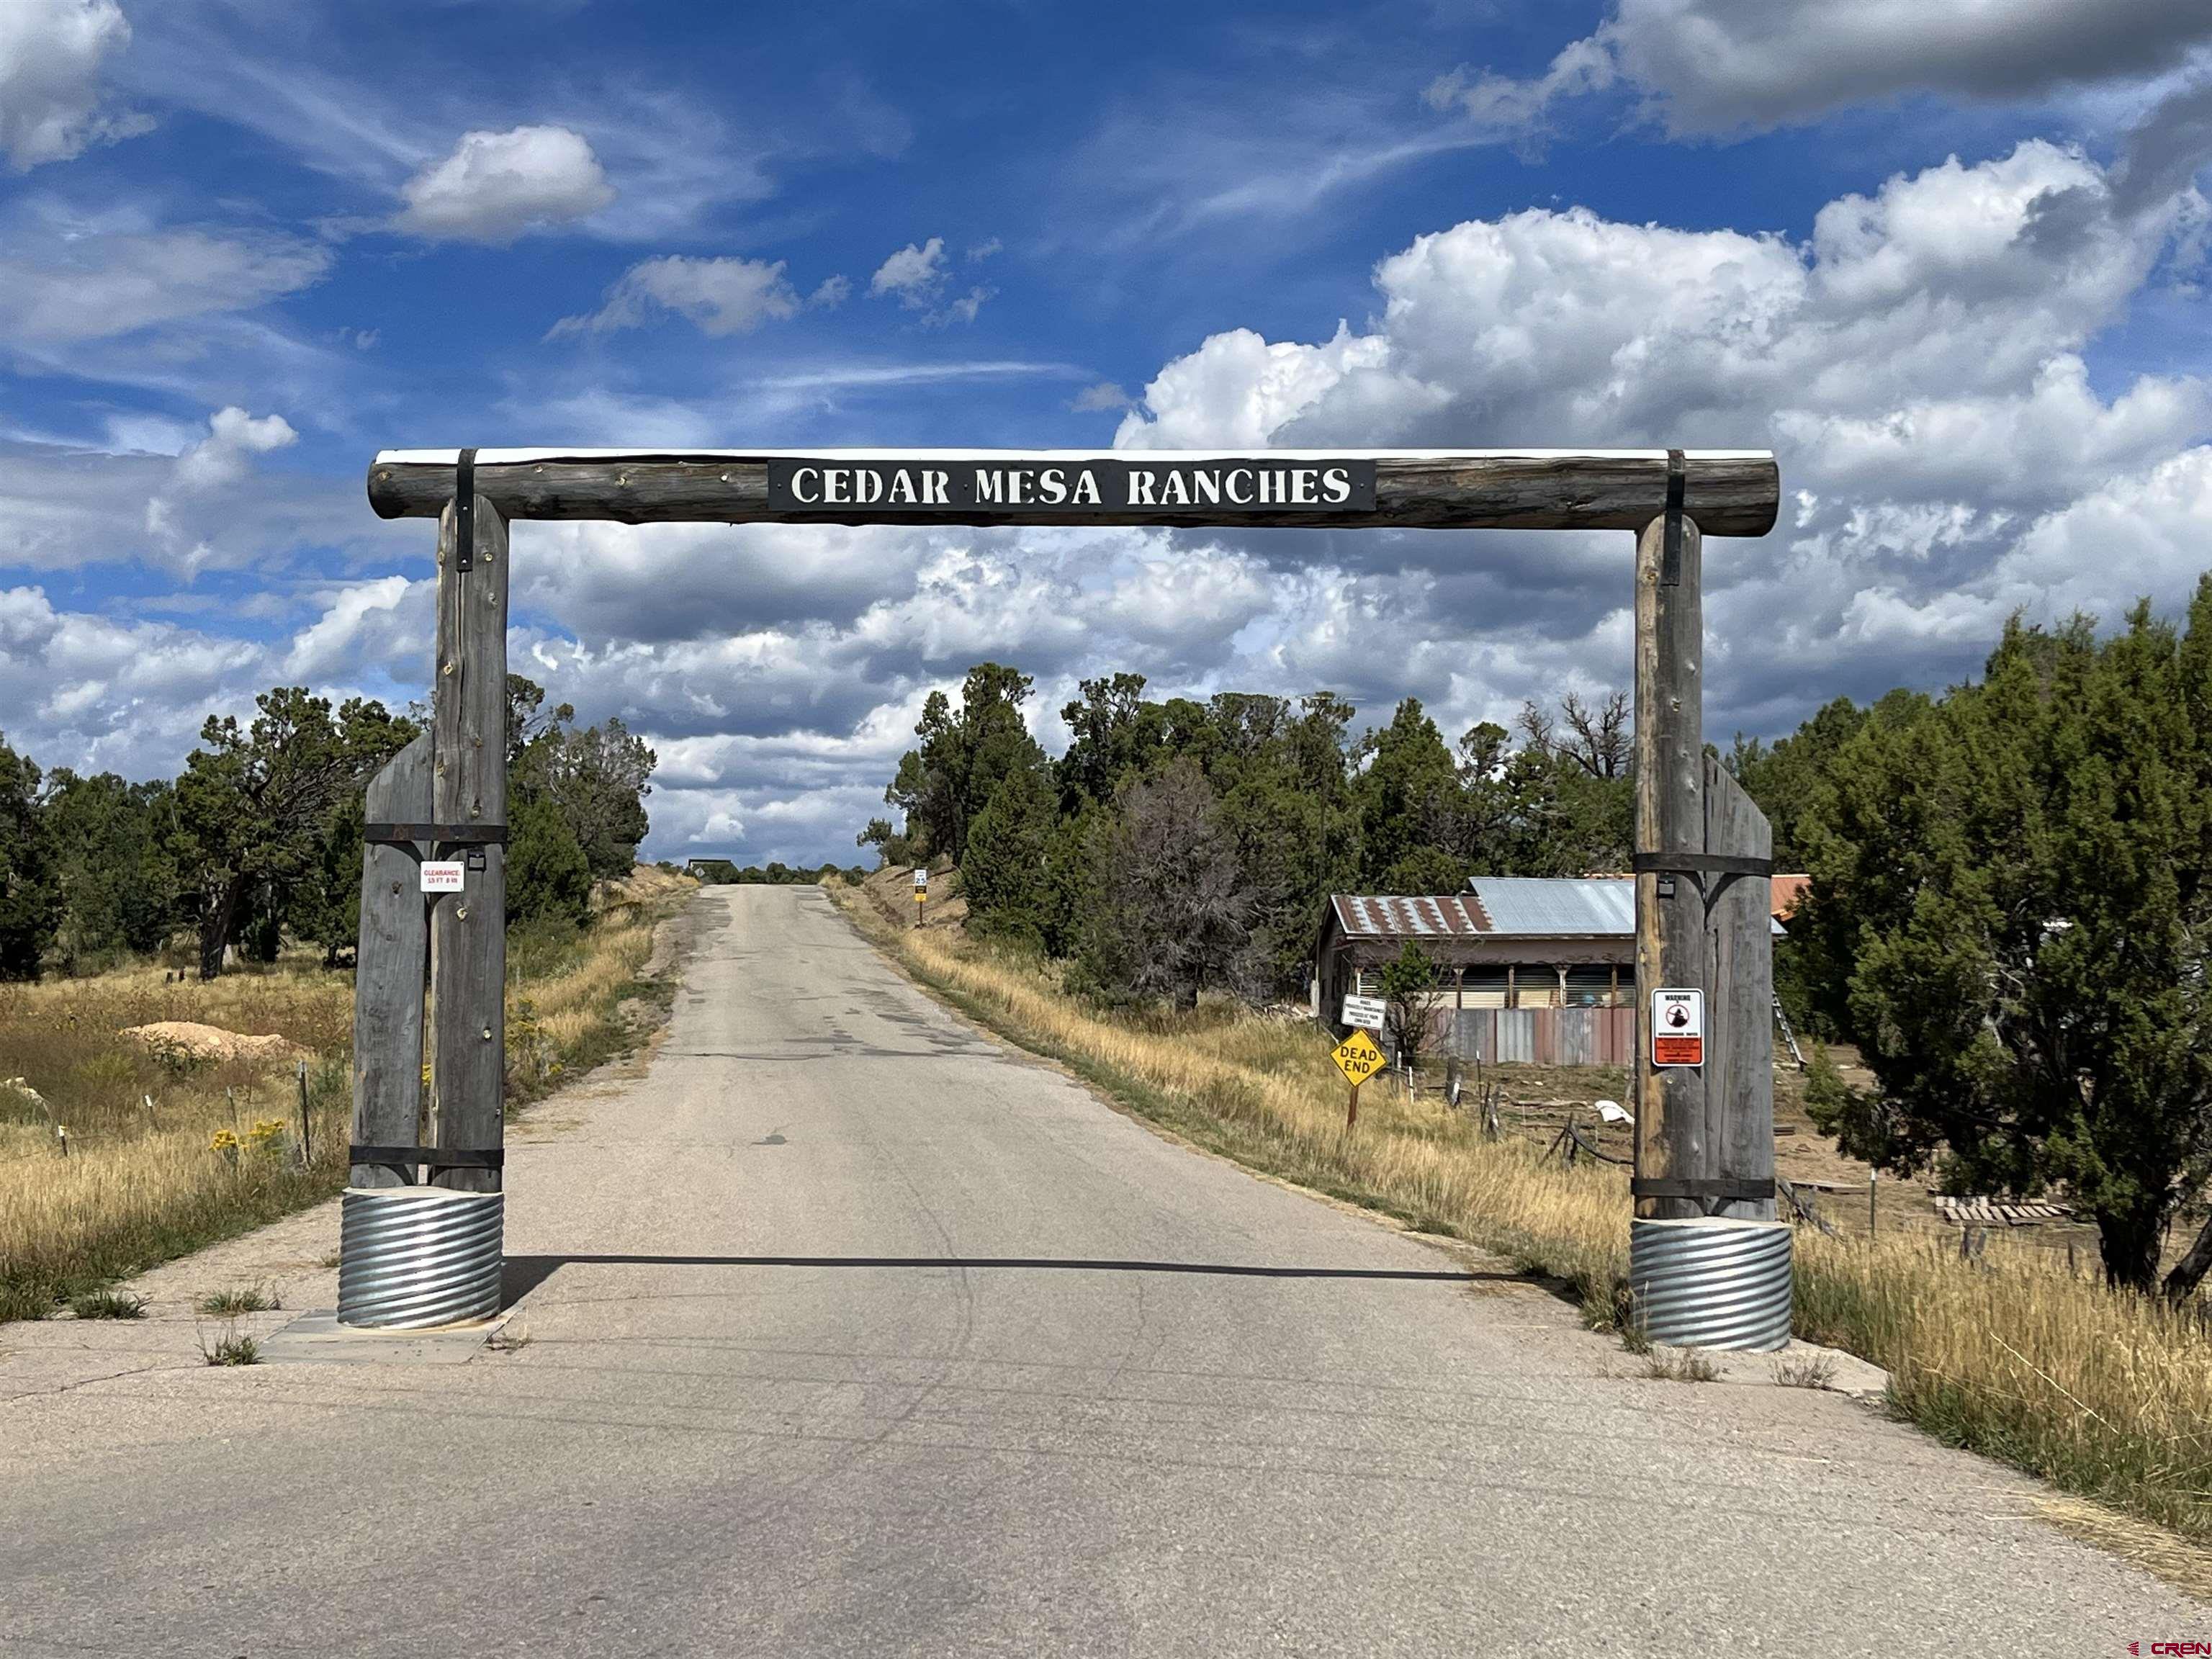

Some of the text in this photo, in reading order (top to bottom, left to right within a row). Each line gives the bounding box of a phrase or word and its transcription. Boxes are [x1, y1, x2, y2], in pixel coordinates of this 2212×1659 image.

[791, 467, 1351, 504] CEDAR MESA RANCHES
[1340, 1046, 1377, 1062] DEAD
[1344, 1059, 1370, 1074] END
